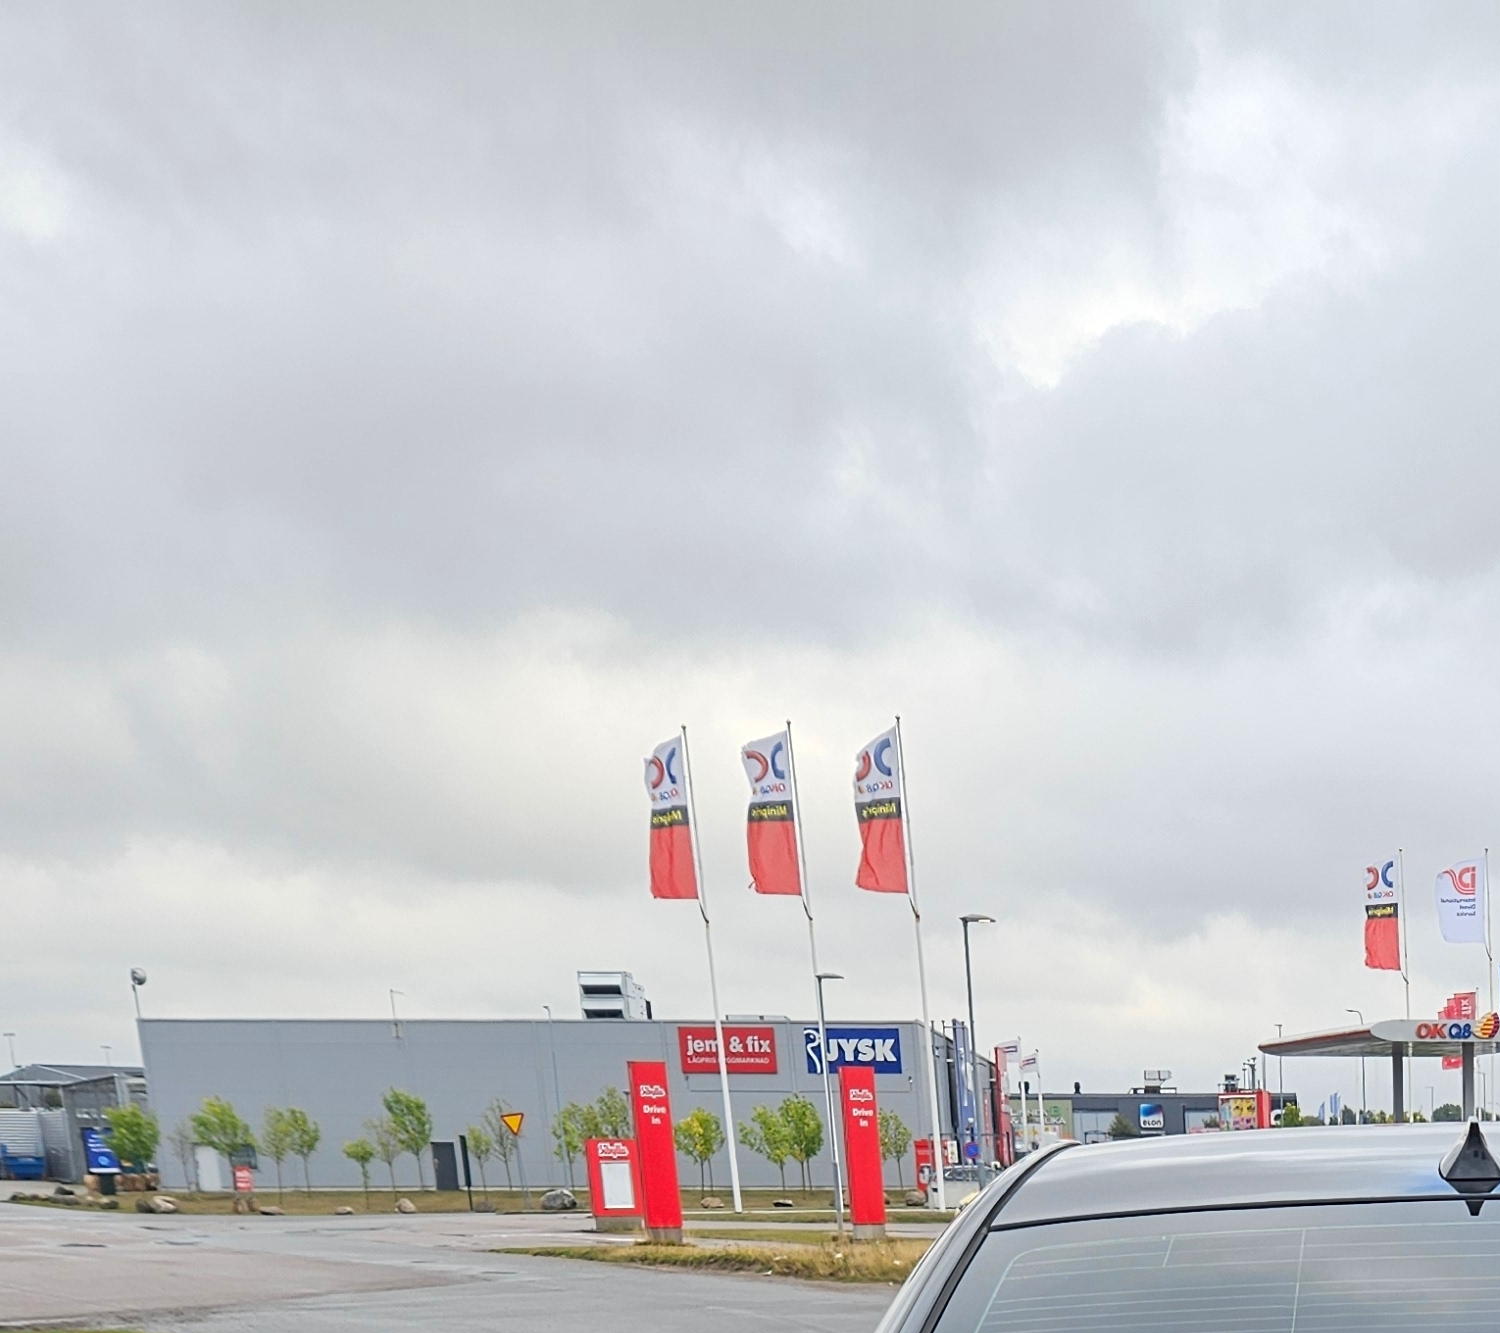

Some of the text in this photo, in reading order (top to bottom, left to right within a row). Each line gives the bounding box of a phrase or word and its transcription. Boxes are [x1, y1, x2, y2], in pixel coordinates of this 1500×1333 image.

[687, 1035, 771, 1055] jem & fix
[826, 1038, 898, 1062] JYSK
[643, 1105, 667, 1114] Drive
[853, 1108, 874, 1117] Drive
